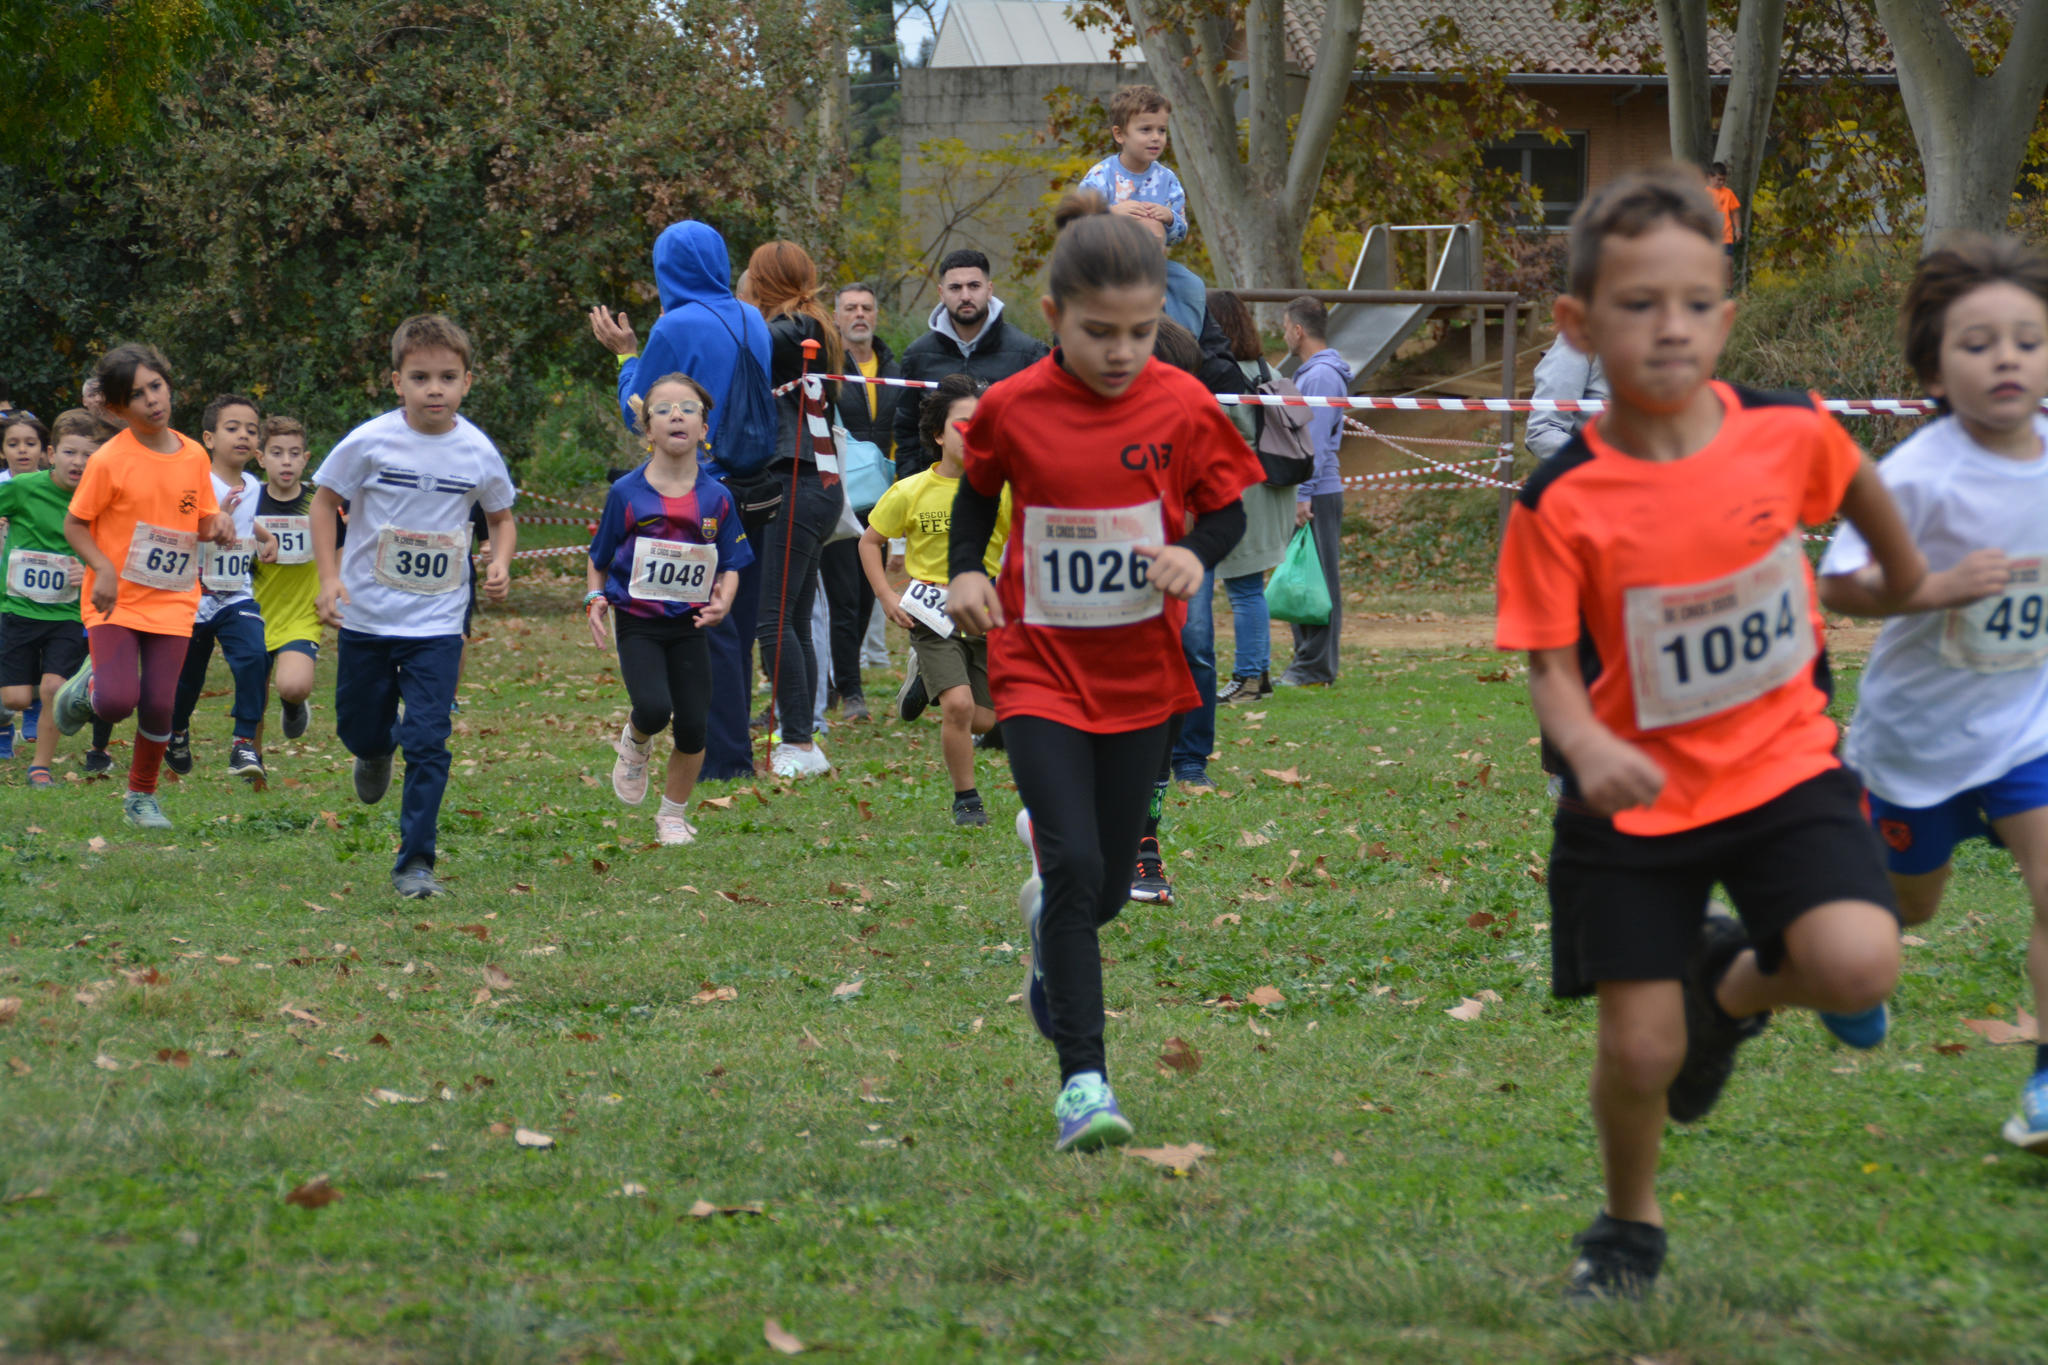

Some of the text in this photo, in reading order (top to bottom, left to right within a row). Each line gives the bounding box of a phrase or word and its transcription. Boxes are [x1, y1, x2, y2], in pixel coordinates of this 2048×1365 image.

[919, 511, 952, 520] ESCOL
[147, 547, 190, 576] 637
[396, 550, 448, 578] 390
[646, 560, 706, 587] 1048
[1043, 548, 1149, 594] 1026
[24, 567, 65, 591] 600
[1662, 589, 1796, 684] 1084
